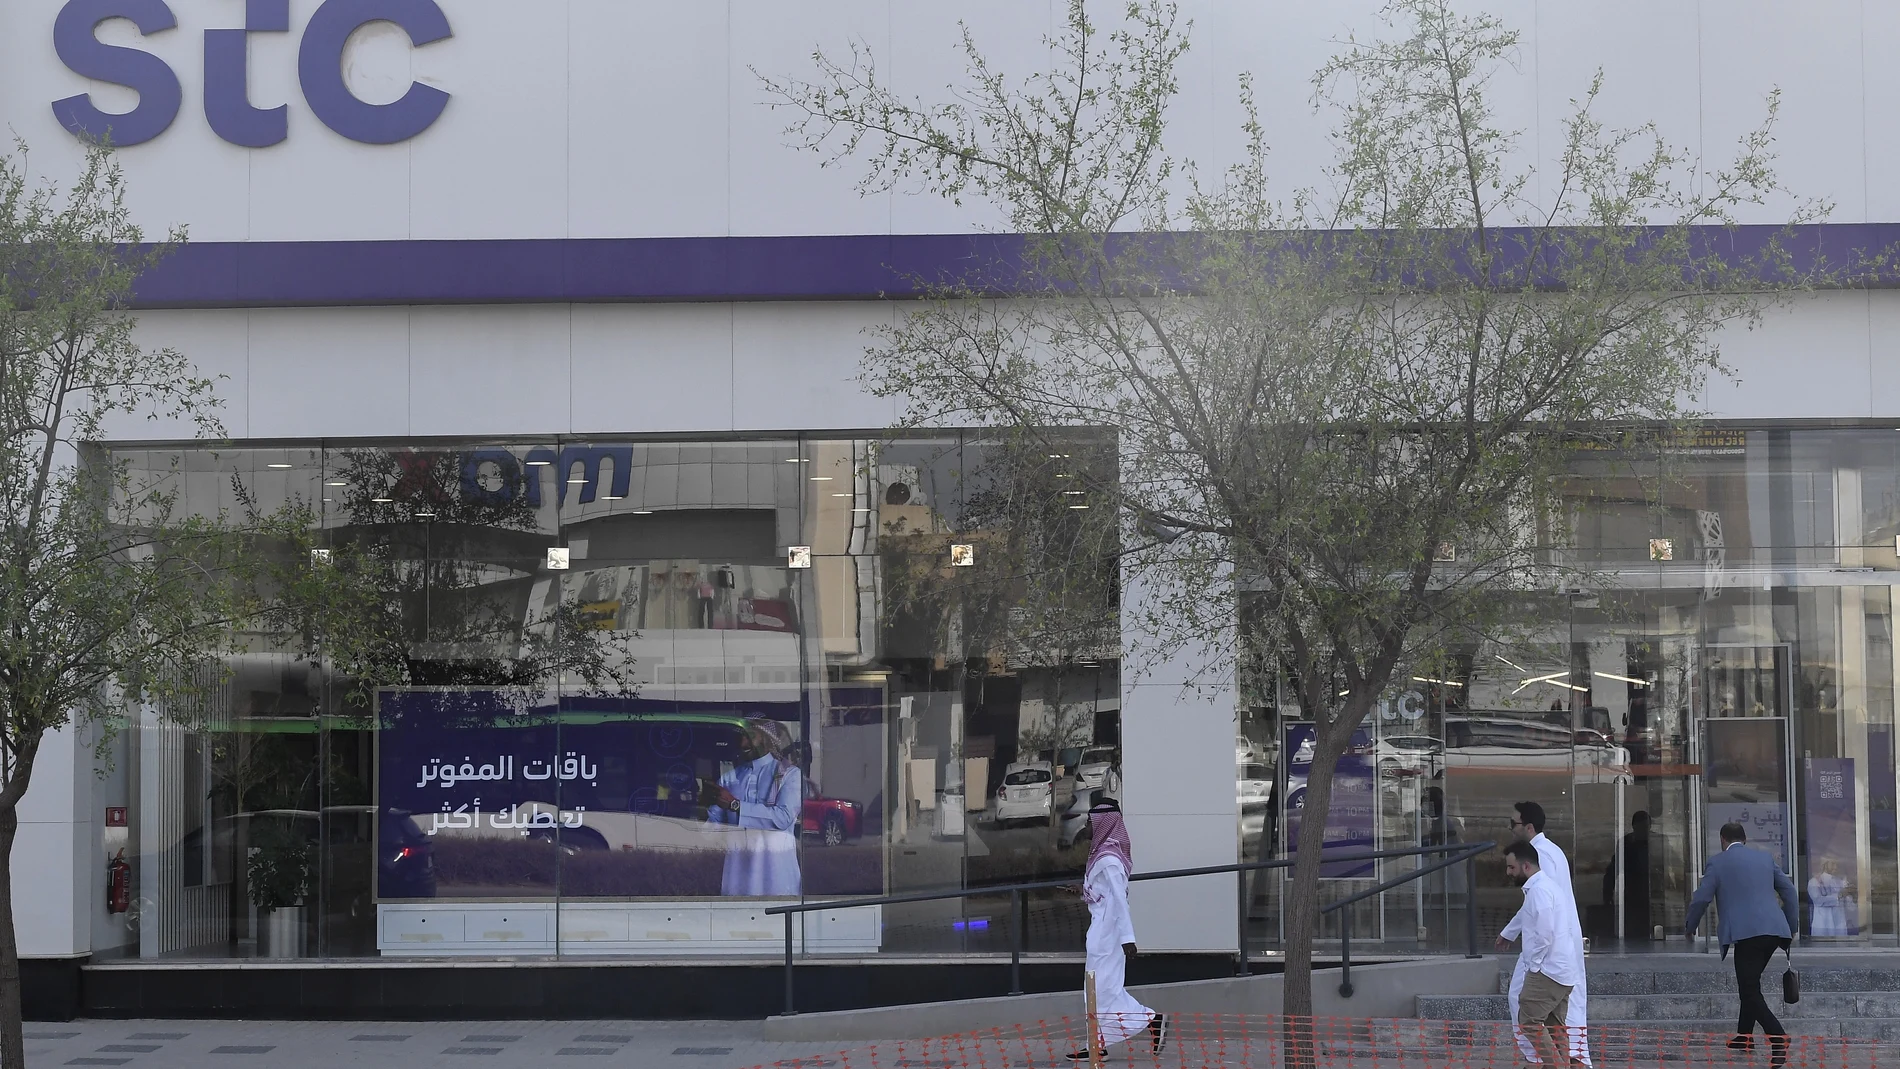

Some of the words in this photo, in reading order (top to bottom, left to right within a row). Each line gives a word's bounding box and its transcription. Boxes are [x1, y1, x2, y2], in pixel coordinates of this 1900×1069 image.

[51, 0, 454, 147] stc
[1375, 684, 1425, 720] tc
[416, 755, 513, 788] المفوتر
[523, 751, 597, 787] باقات
[427, 797, 481, 836] أكثر
[489, 803, 586, 836] تعطيك
[1753, 810, 1783, 830] بيتي
